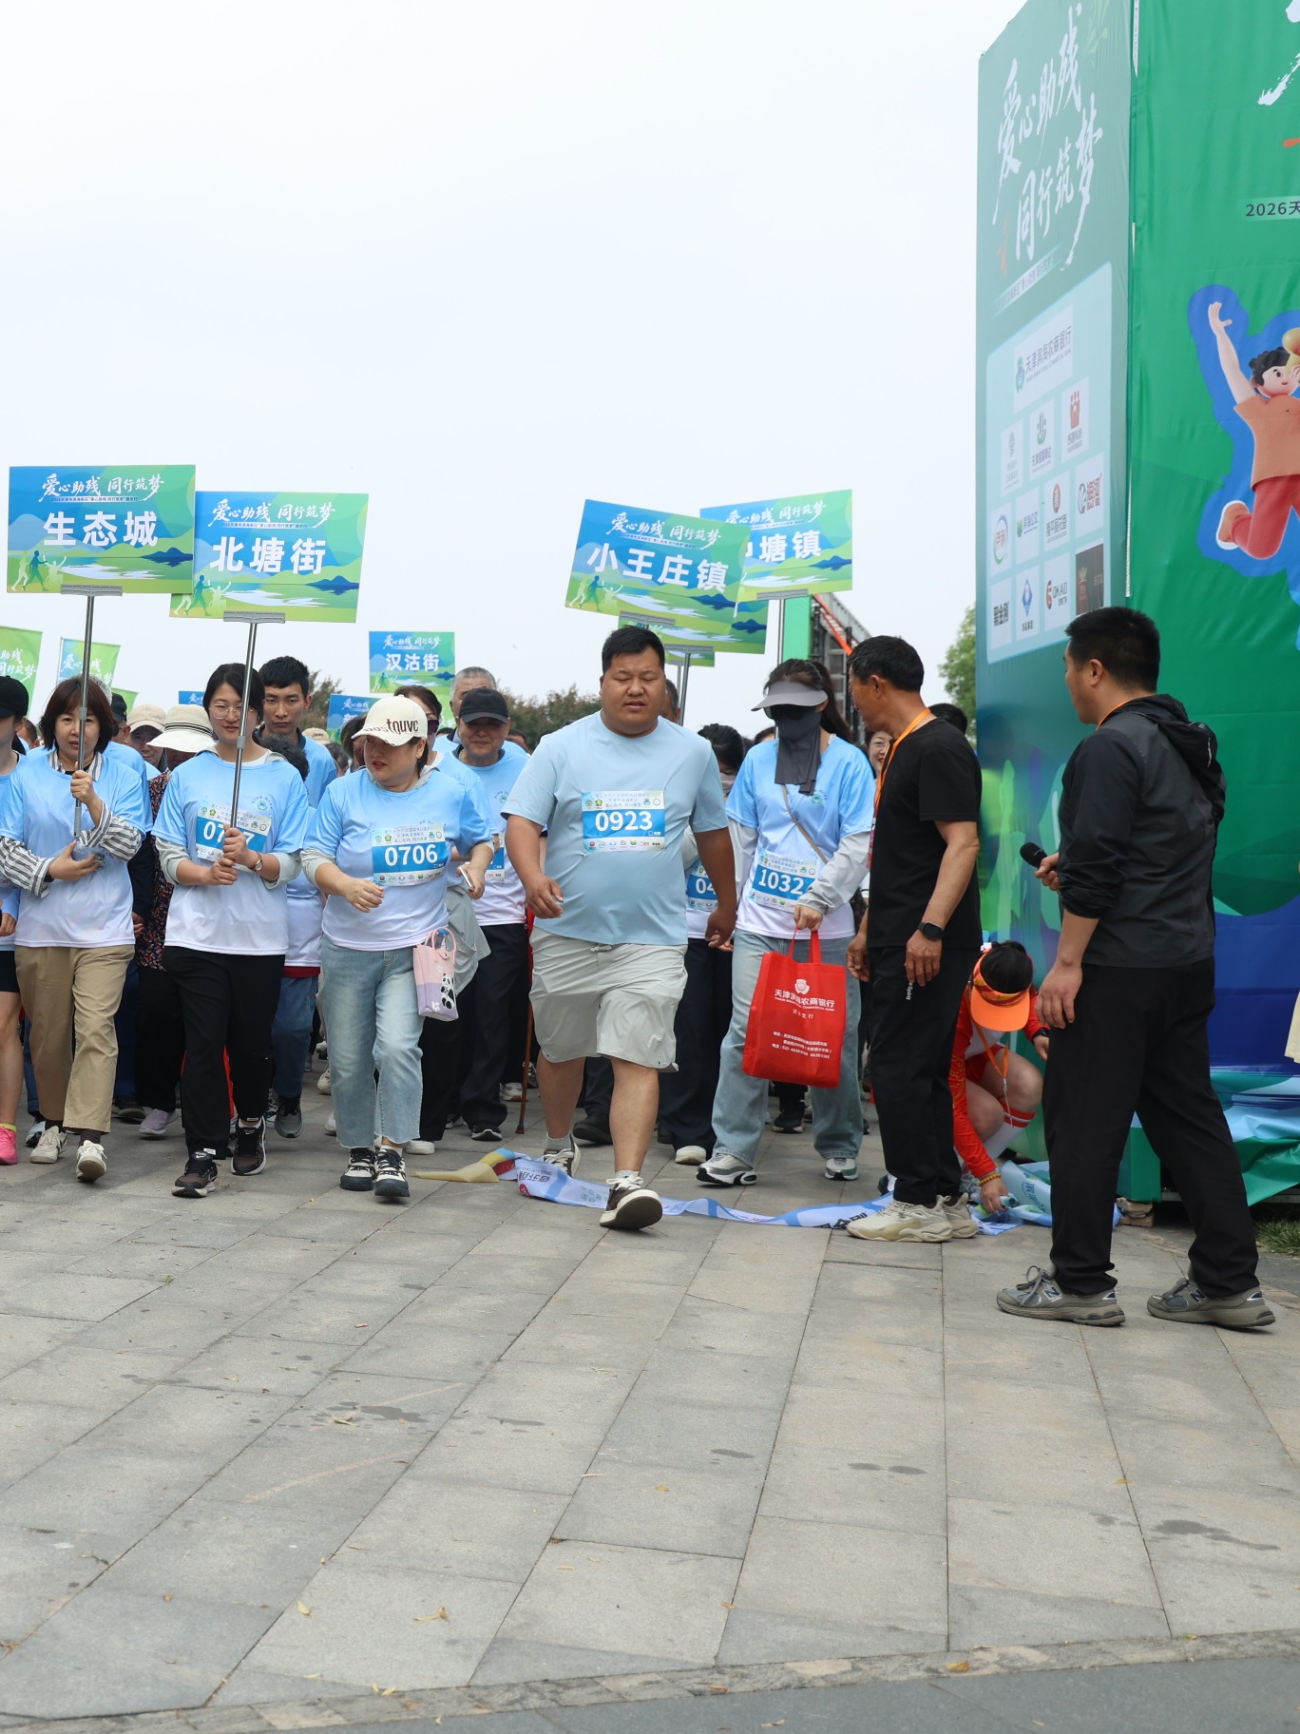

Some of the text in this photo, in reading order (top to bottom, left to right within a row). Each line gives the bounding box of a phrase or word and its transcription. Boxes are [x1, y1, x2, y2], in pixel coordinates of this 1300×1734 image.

[38, 473, 164, 502] 爱心助残 同行筑梦
[208, 498, 335, 528] 爱心助残 同行筑梦
[726, 499, 827, 524] 爱心助残 同行筑梦
[43, 511, 158, 547] 生态城
[606, 511, 665, 538] 爱心助残
[669, 527, 722, 550] 同行筑梦
[210, 536, 326, 575] 北塘街
[587, 542, 729, 594] 小王庄镇
[60, 654, 103, 673] 爱心残
[386, 653, 440, 672] 汉沽街
[203, 821, 255, 848] 077
[595, 810, 653, 832] 0923
[384, 844, 438, 867] 0706
[758, 869, 804, 895] 1032
